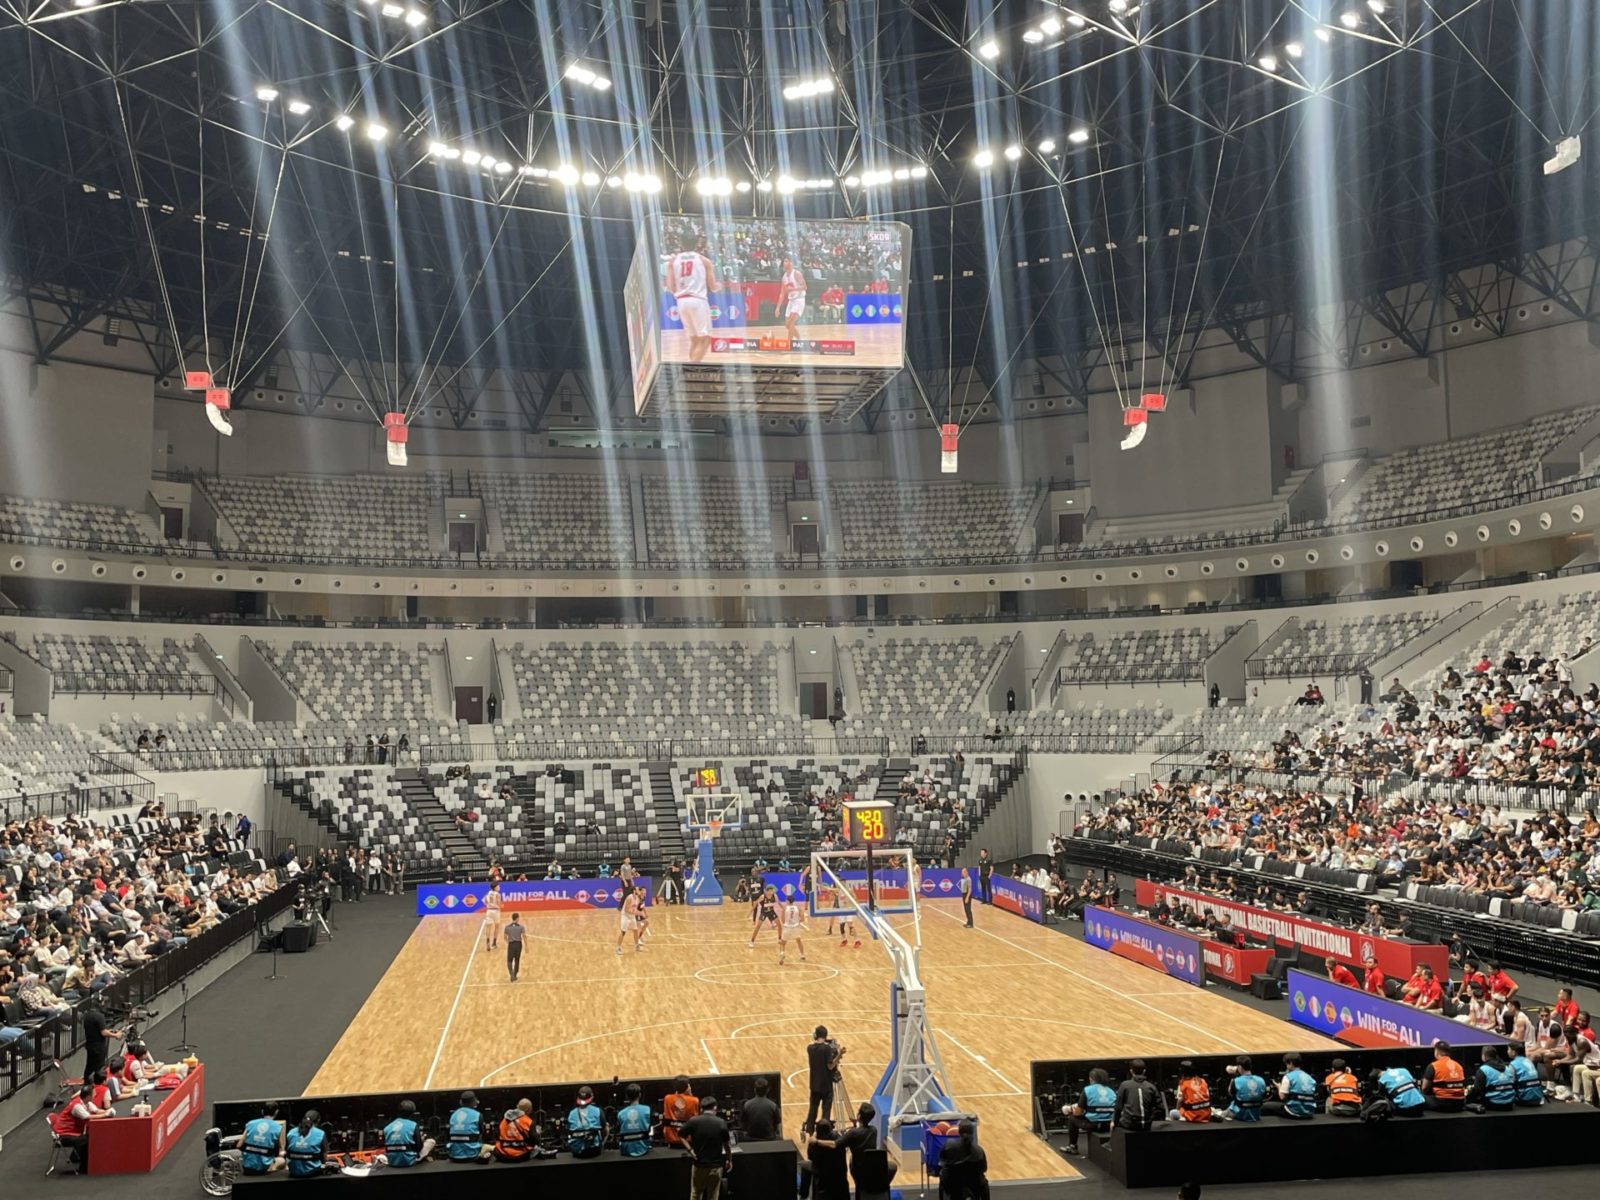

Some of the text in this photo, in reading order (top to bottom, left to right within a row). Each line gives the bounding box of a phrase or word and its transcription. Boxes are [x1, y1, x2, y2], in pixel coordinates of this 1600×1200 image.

[863, 823, 884, 840] 20
[502, 890, 570, 902] WIN FOR ALL
[1119, 929, 1133, 945] WIN
[1141, 936, 1155, 953] ALL
[1247, 912, 1294, 941] BASKETBALL
[1294, 924, 1353, 958] INVITATIONAL
[1357, 1010, 1421, 1047] WIN FOR ALL
